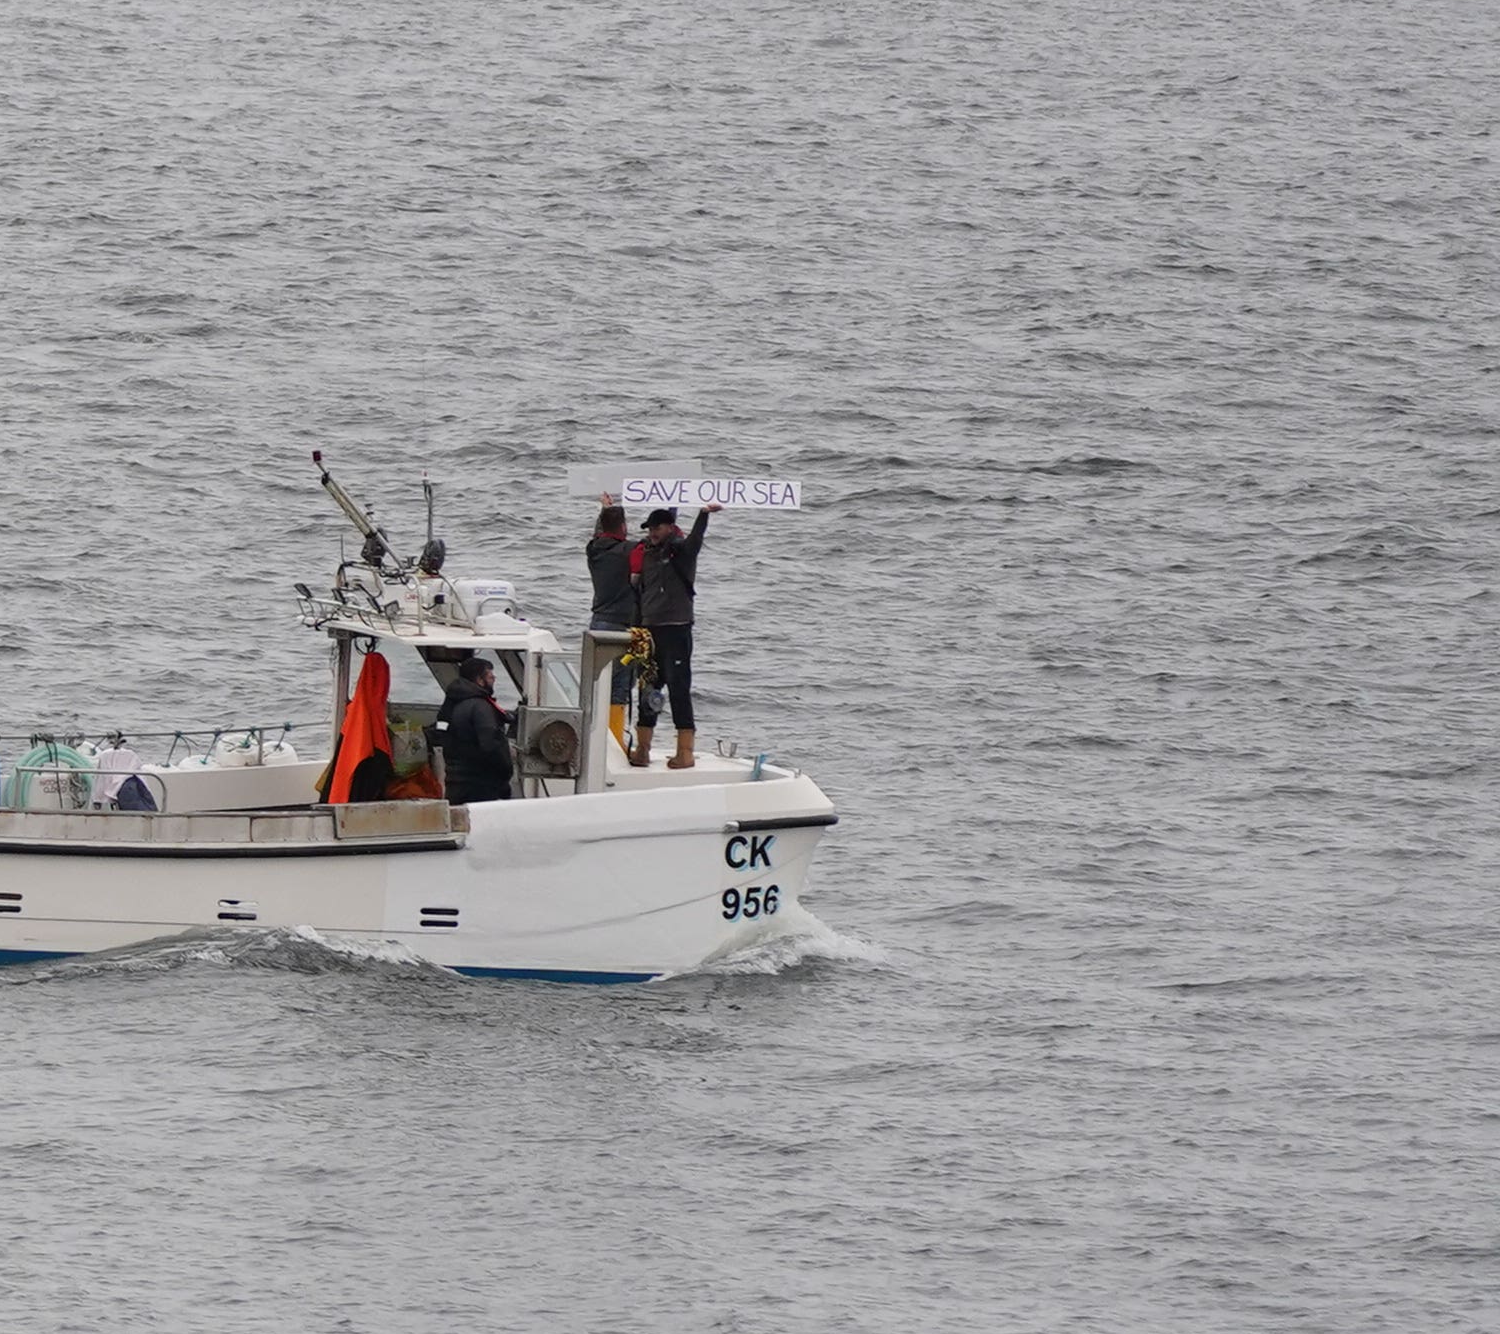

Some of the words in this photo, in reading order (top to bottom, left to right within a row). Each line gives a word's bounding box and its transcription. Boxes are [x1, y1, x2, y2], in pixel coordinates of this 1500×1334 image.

[624, 479, 691, 503] SAVE
[698, 480, 746, 504] OUR
[751, 482, 796, 505] SEA
[724, 835, 775, 869] CK
[722, 884, 779, 921] 956
